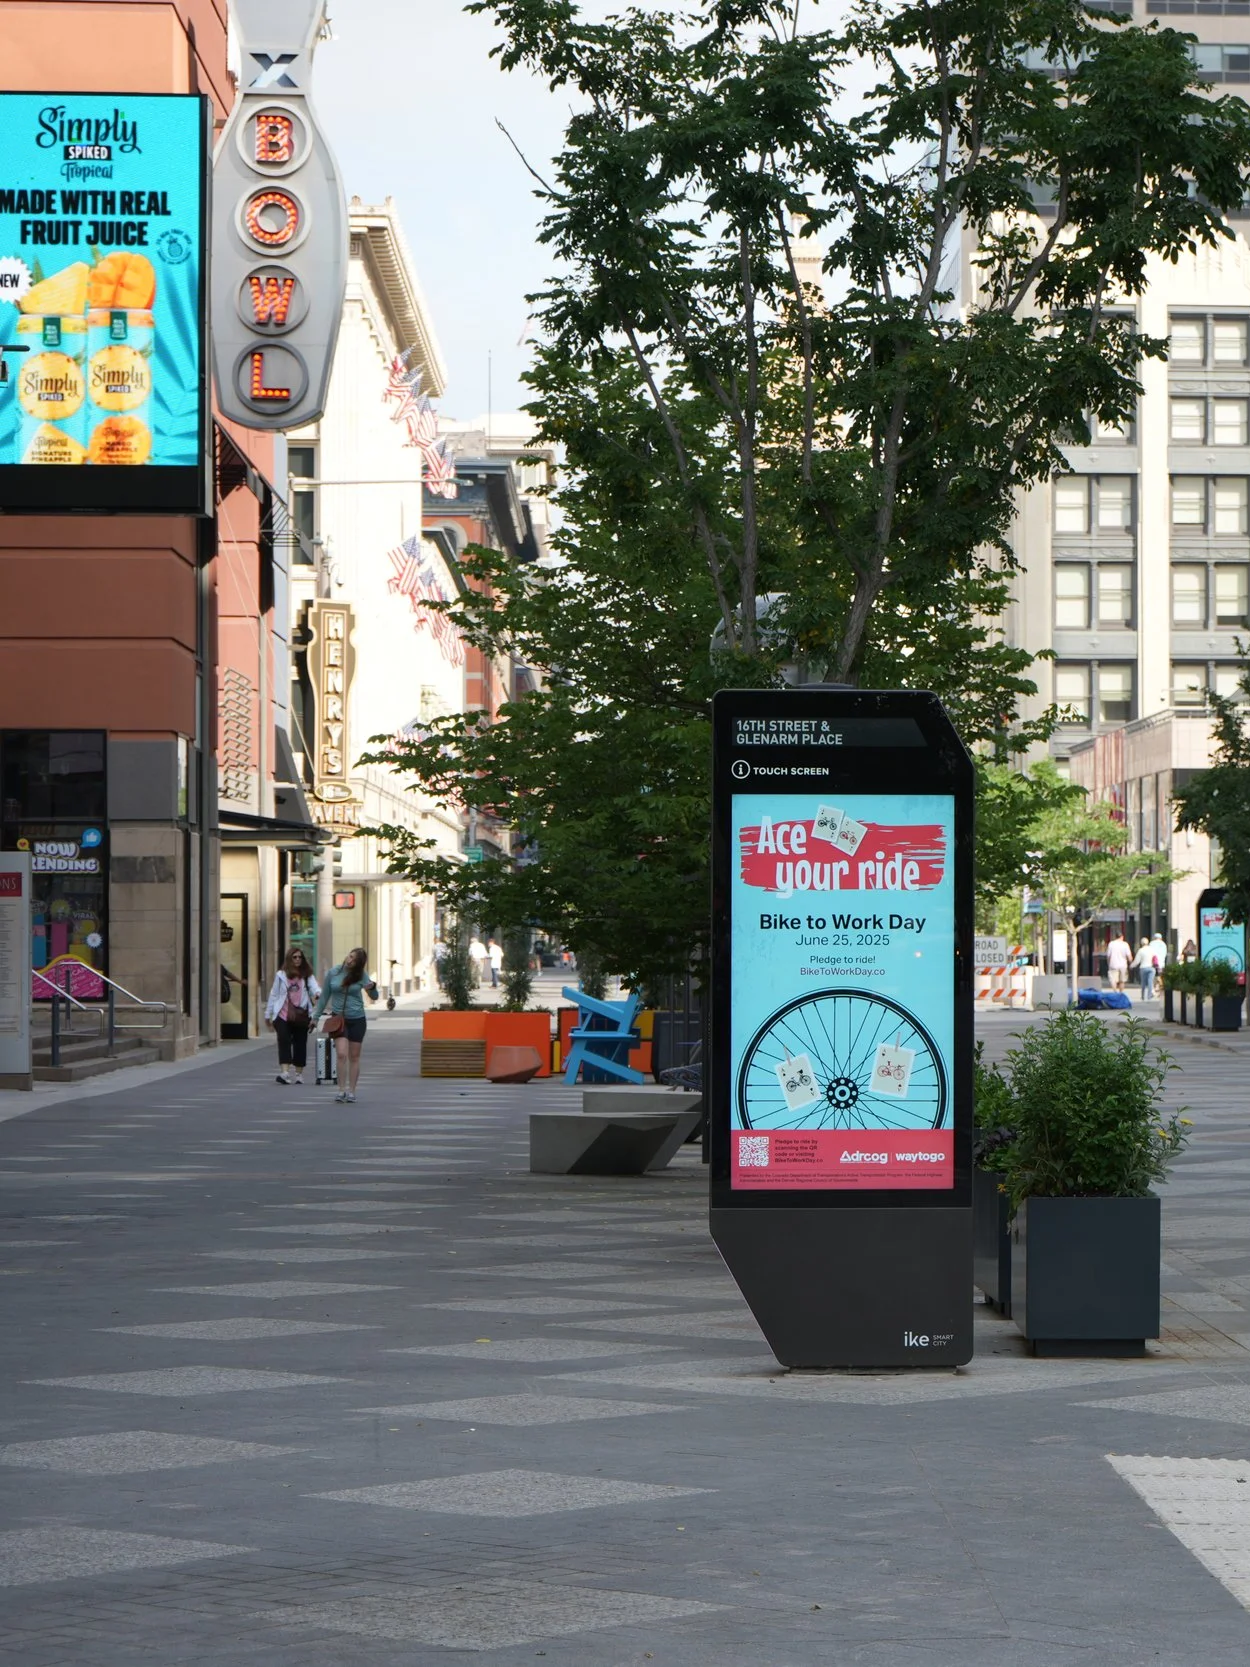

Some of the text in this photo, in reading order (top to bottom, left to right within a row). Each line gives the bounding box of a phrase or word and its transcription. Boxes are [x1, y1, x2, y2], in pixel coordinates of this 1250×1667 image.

[35, 105, 142, 154] Simply
[68, 146, 108, 160] SPIKED
[60, 162, 114, 182] Tropical
[0, 189, 171, 216] MADE WITH REAL
[20, 220, 148, 246] FRUIT JUICE
[246, 114, 299, 401] BOWL
[24, 371, 79, 398] Simply
[92, 364, 146, 390] Simply
[107, 385, 130, 393] SPIKED
[40, 393, 63, 401] SPIKED
[324, 613, 344, 776] HENRY'S
[736, 720, 830, 732] 16TH STREET &
[736, 733, 843, 745] GLENARM PLACE
[753, 767, 829, 776] TOUCH SCREEN
[757, 816, 807, 855] Ace
[34, 841, 77, 857] NOW
[32, 856, 98, 871] ENDING
[775, 851, 920, 899] your ride
[760, 914, 926, 933] Bike to Work Day
[796, 934, 890, 947] June 25, 2025
[975, 940, 999, 950] ROAD
[810, 956, 842, 966] Pledge
[855, 956, 876, 964] ride!
[975, 953, 1005, 963] LOSED
[800, 967, 886, 977] BikeToWorkDay.co
[895, 1151, 945, 1162] waytogo
[904, 1331, 930, 1347] ike
